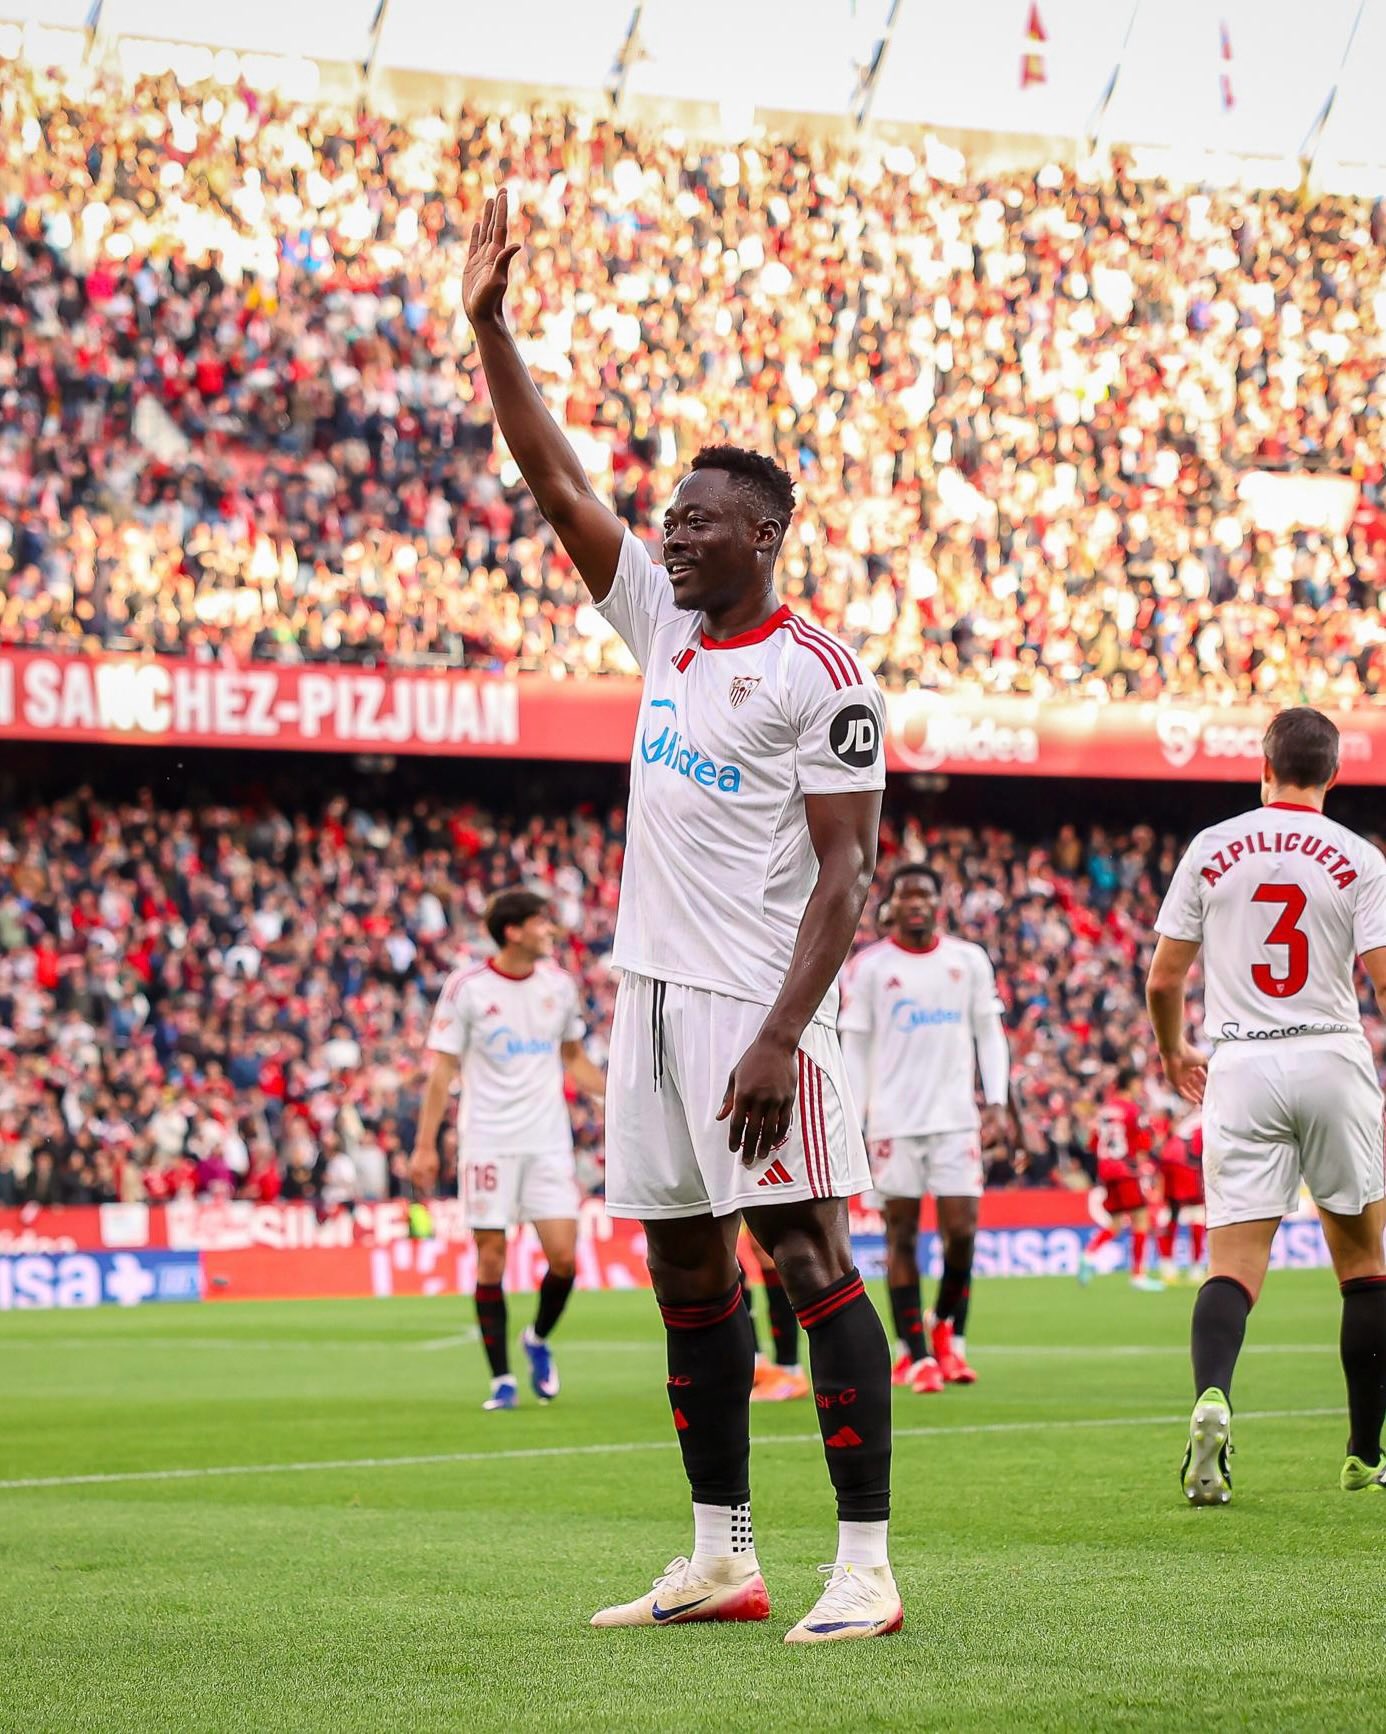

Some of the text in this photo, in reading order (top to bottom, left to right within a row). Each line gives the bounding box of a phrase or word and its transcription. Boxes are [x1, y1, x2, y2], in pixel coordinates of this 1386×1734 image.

[641, 701, 742, 793] Midea
[838, 719, 875, 754] JD
[1201, 831, 1358, 890] AZPILICUETA
[1251, 883, 1309, 998] 3
[474, 1163, 497, 1191] 16
